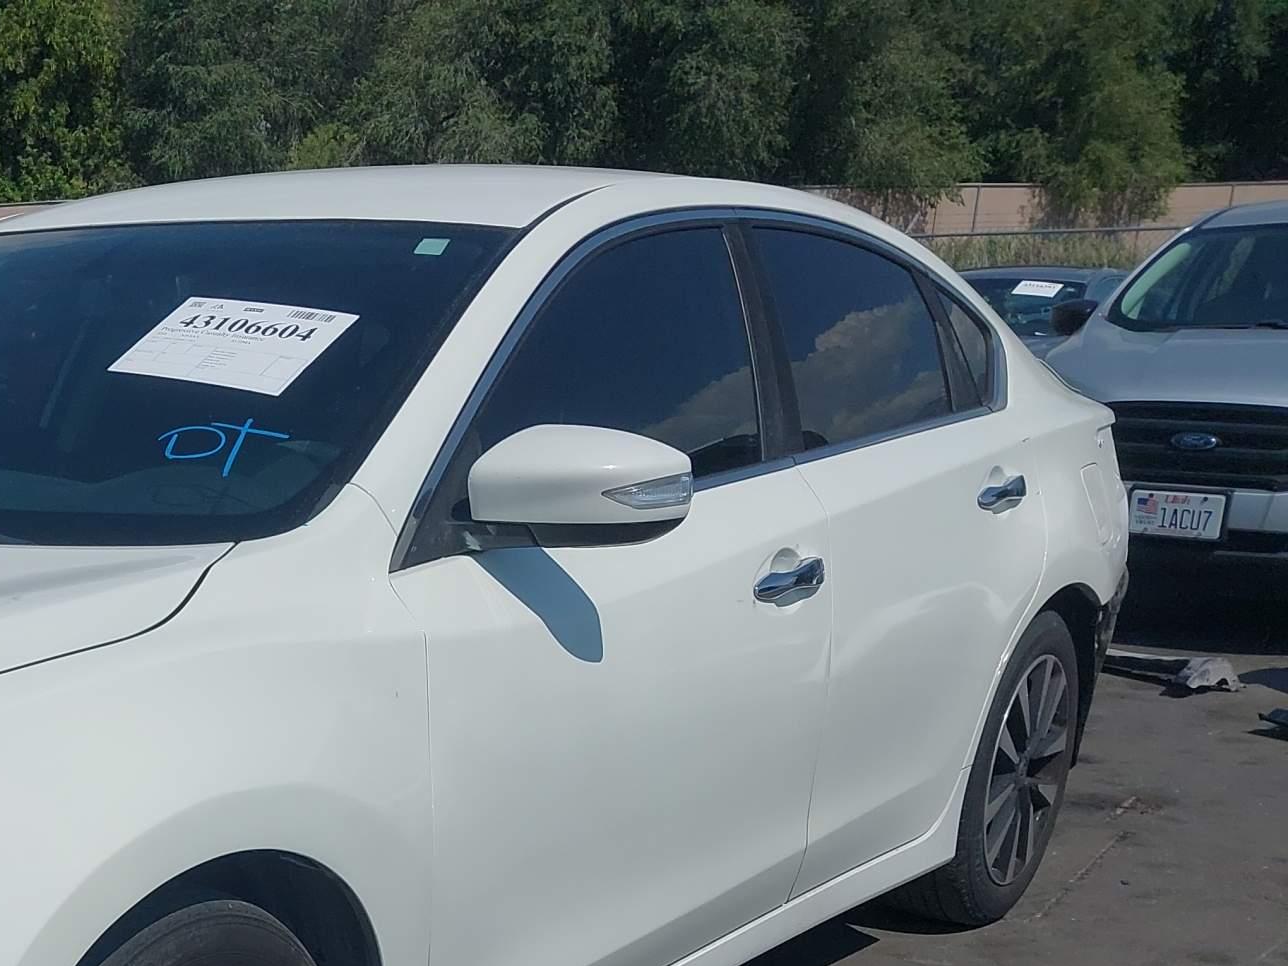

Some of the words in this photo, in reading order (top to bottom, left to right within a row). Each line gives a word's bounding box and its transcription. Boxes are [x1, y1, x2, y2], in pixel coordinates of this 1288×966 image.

[179, 314, 318, 342] 43106604
[158, 418, 289, 477] DT
[1157, 507, 1213, 532] 1ACU7
